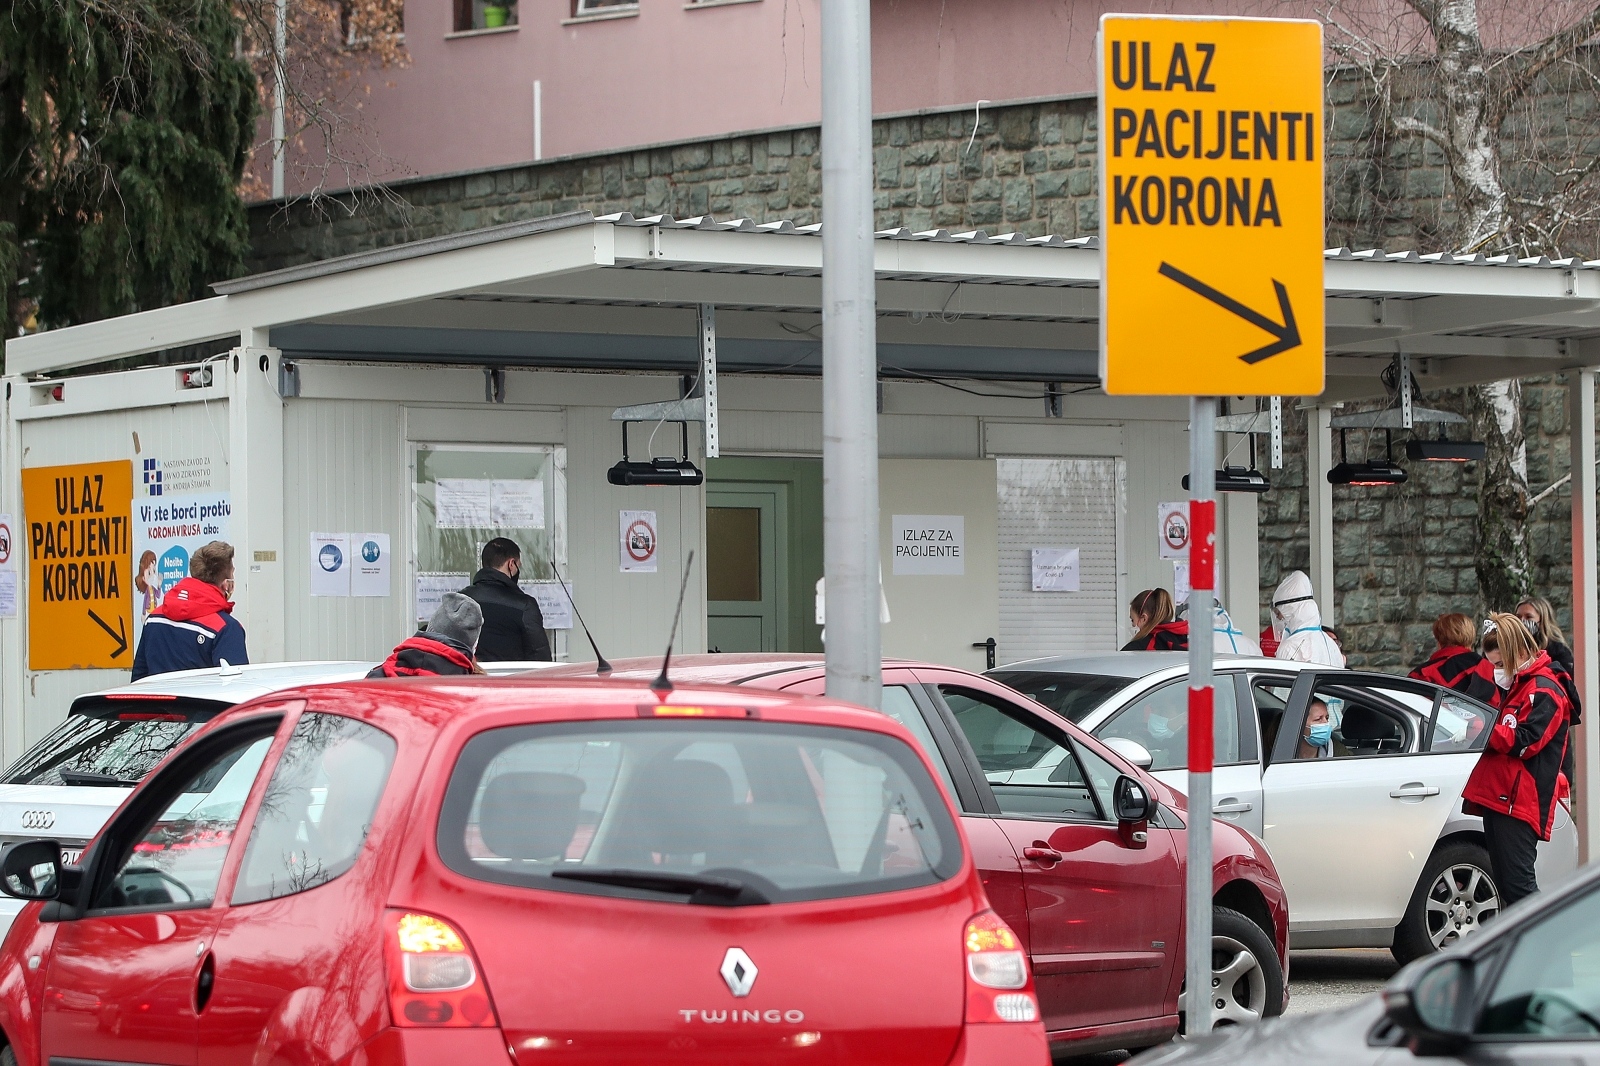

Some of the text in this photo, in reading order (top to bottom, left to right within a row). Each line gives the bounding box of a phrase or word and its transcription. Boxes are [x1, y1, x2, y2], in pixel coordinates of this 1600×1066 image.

[1112, 41, 1216, 92] ULAZ
[1113, 108, 1314, 161] PACIJENTI
[1113, 175, 1282, 227] KORONA
[164, 457, 211, 468] NASTAVNI ZAVOD ZA
[164, 469, 211, 481] JAVNO ZDRAVSTVO
[173, 482, 190, 491] ANDRIJA
[191, 479, 211, 489] ŠTAMPAR
[55, 475, 104, 515] ULAZ
[140, 505, 151, 522] Vi
[154, 506, 169, 521] ste
[171, 502, 197, 520] borci
[32, 516, 127, 559] PACIJENTI
[148, 523, 219, 539] KORONAVIRUSA ako:
[903, 530, 953, 541] IZLAZ ZA
[896, 545, 960, 557] PACIJENTE
[164, 557, 183, 567] Nosite
[43, 561, 119, 601] KORONA
[164, 569, 183, 579] masku
[678, 1009, 805, 1023] TWINGO
